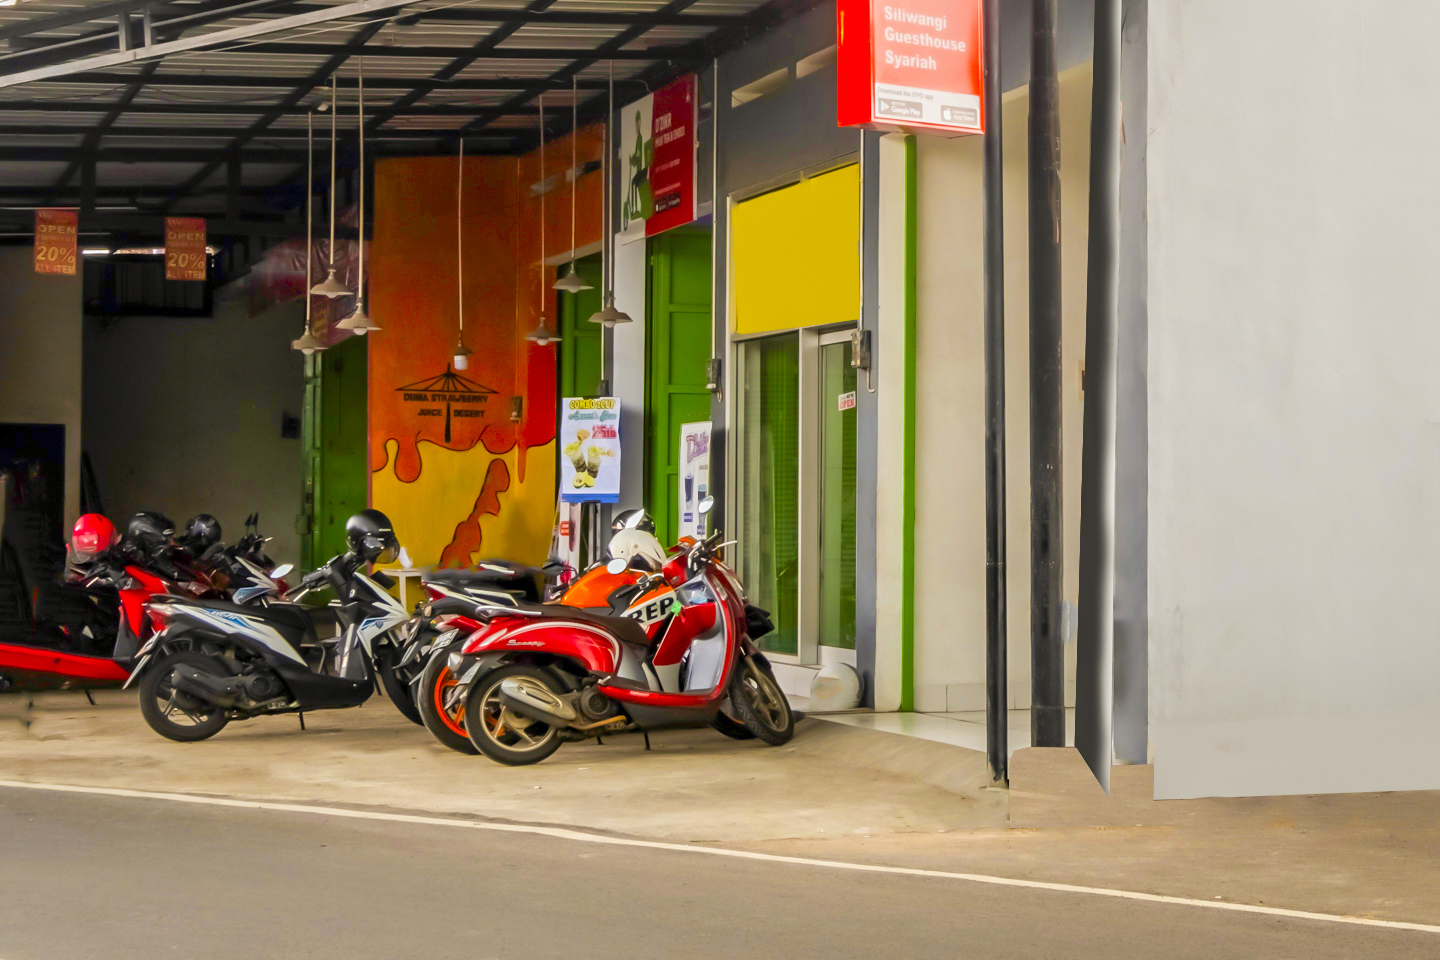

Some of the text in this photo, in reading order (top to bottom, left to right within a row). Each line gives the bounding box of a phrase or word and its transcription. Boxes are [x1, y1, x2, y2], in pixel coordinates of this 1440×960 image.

[884, 5, 947, 31] Siliwangi
[884, 27, 966, 52] Guesthouse
[885, 49, 937, 70] Syariah
[891, 106, 921, 117] Google Play
[38, 224, 76, 235] OPEN
[168, 231, 205, 241] OPEN
[36, 245, 76, 264] 20%
[167, 252, 205, 269] 20%
[53, 264, 76, 275] ITEM
[166, 270, 206, 280] ALL ITEM
[403, 393, 488, 403] DUNIA STRAWBERRY
[569, 399, 595, 410] COMBO
[839, 398, 855, 410] OPEN
[417, 408, 485, 418] JUICE DESERT
